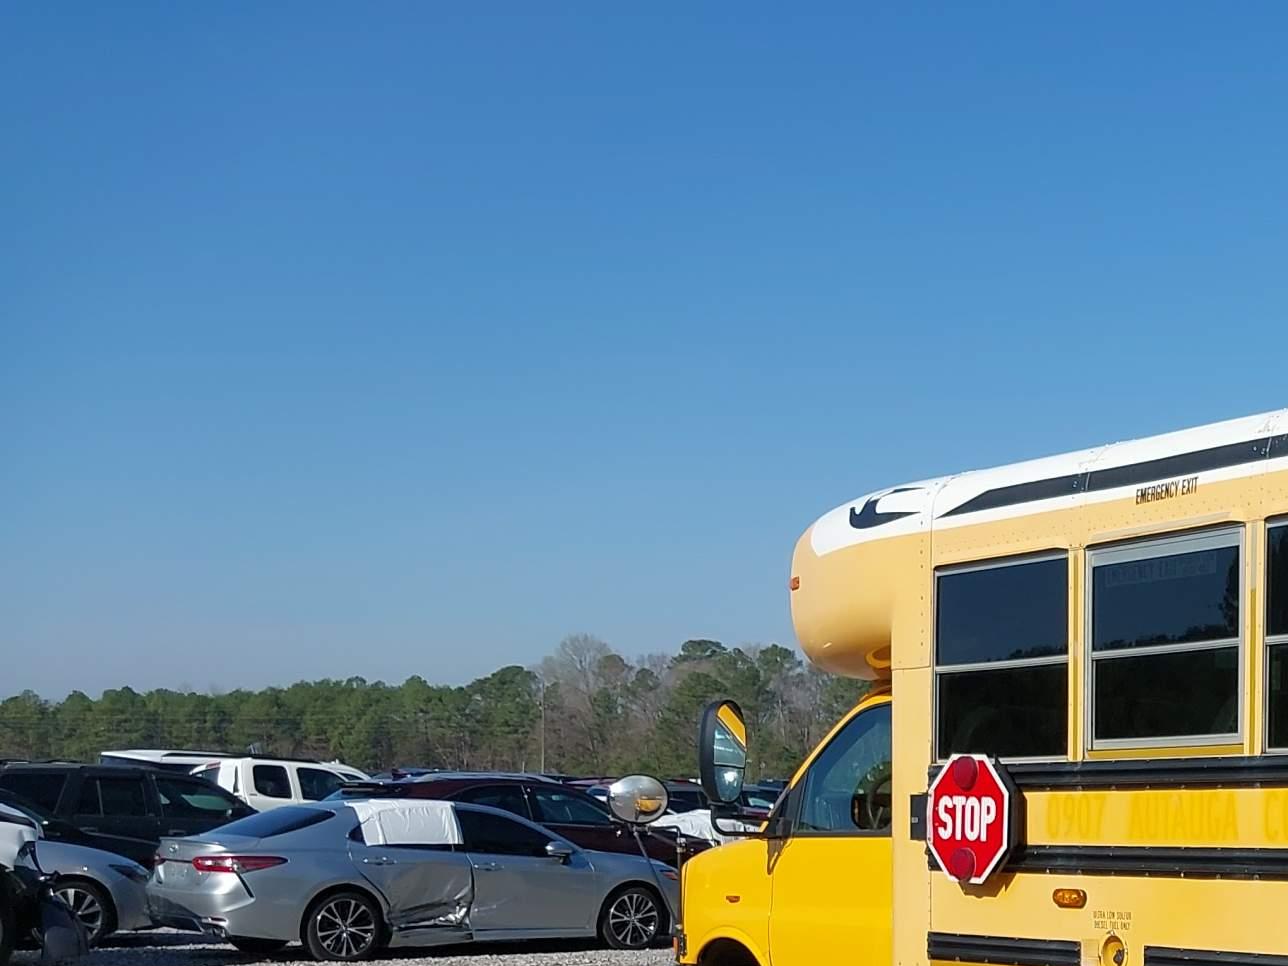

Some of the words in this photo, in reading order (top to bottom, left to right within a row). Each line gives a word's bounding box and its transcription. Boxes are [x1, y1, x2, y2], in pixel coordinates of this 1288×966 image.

[1136, 480, 1180, 505] EMERGENCY
[1181, 476, 1198, 495] EXIT
[938, 795, 996, 842] STOP
